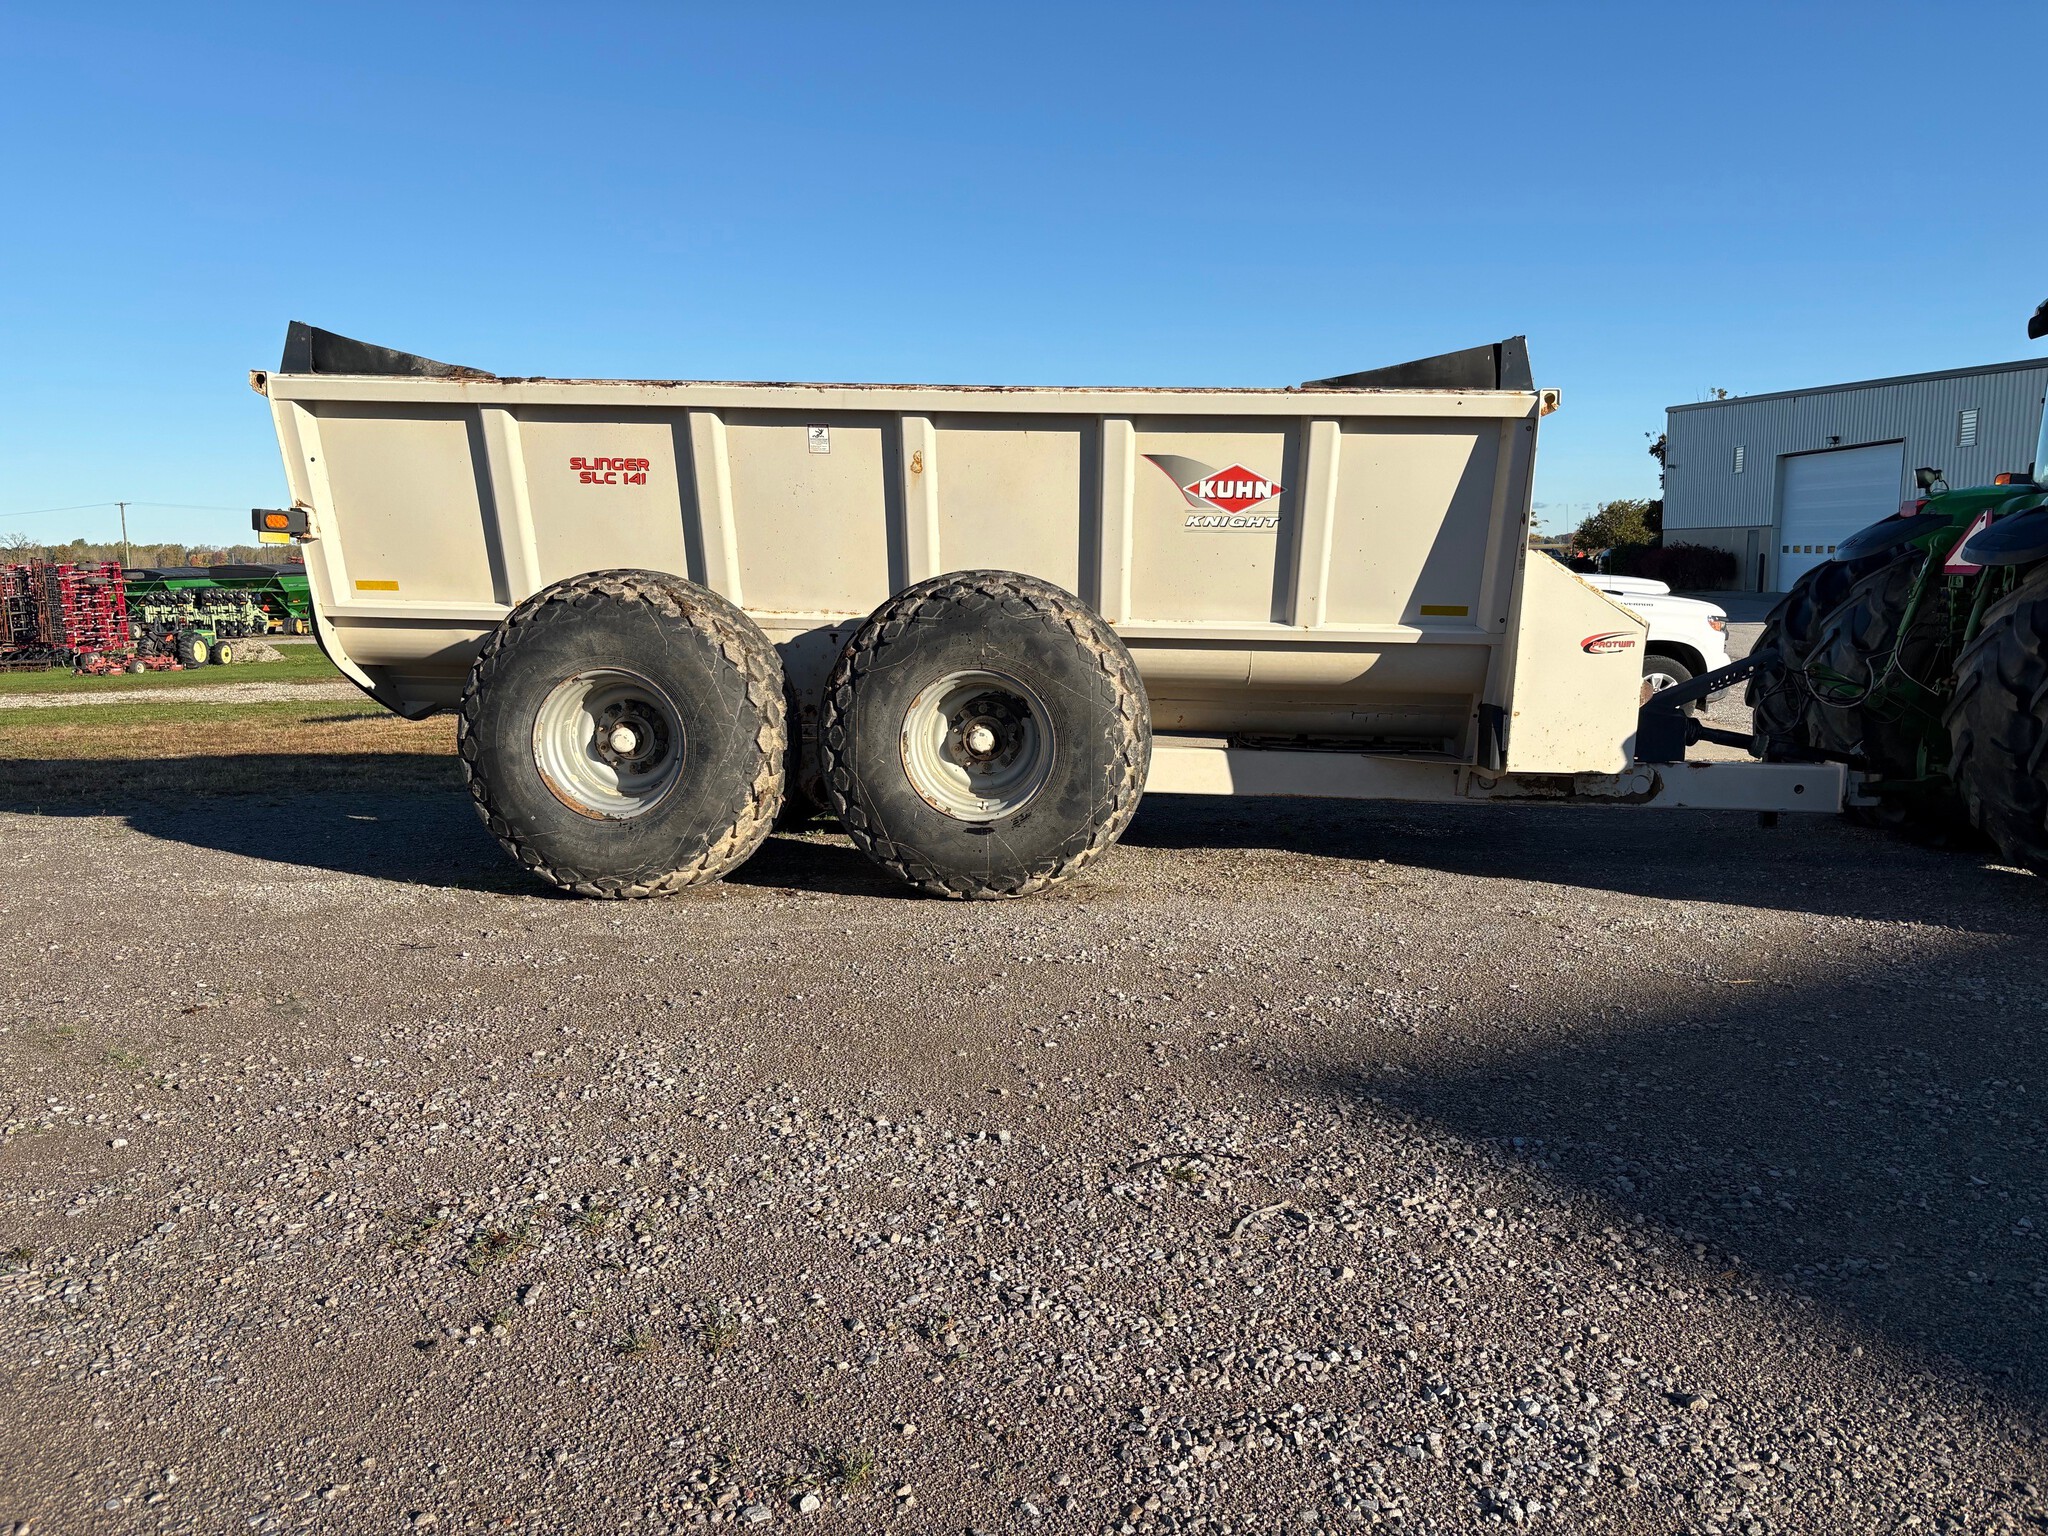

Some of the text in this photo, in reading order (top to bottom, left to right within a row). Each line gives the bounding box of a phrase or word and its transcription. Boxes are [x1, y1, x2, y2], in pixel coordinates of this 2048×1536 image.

[569, 457, 650, 471] SLINGER
[579, 471, 647, 485] SLC 141
[1198, 480, 1273, 499] KUHN
[1184, 515, 1282, 528] KNIGHT
